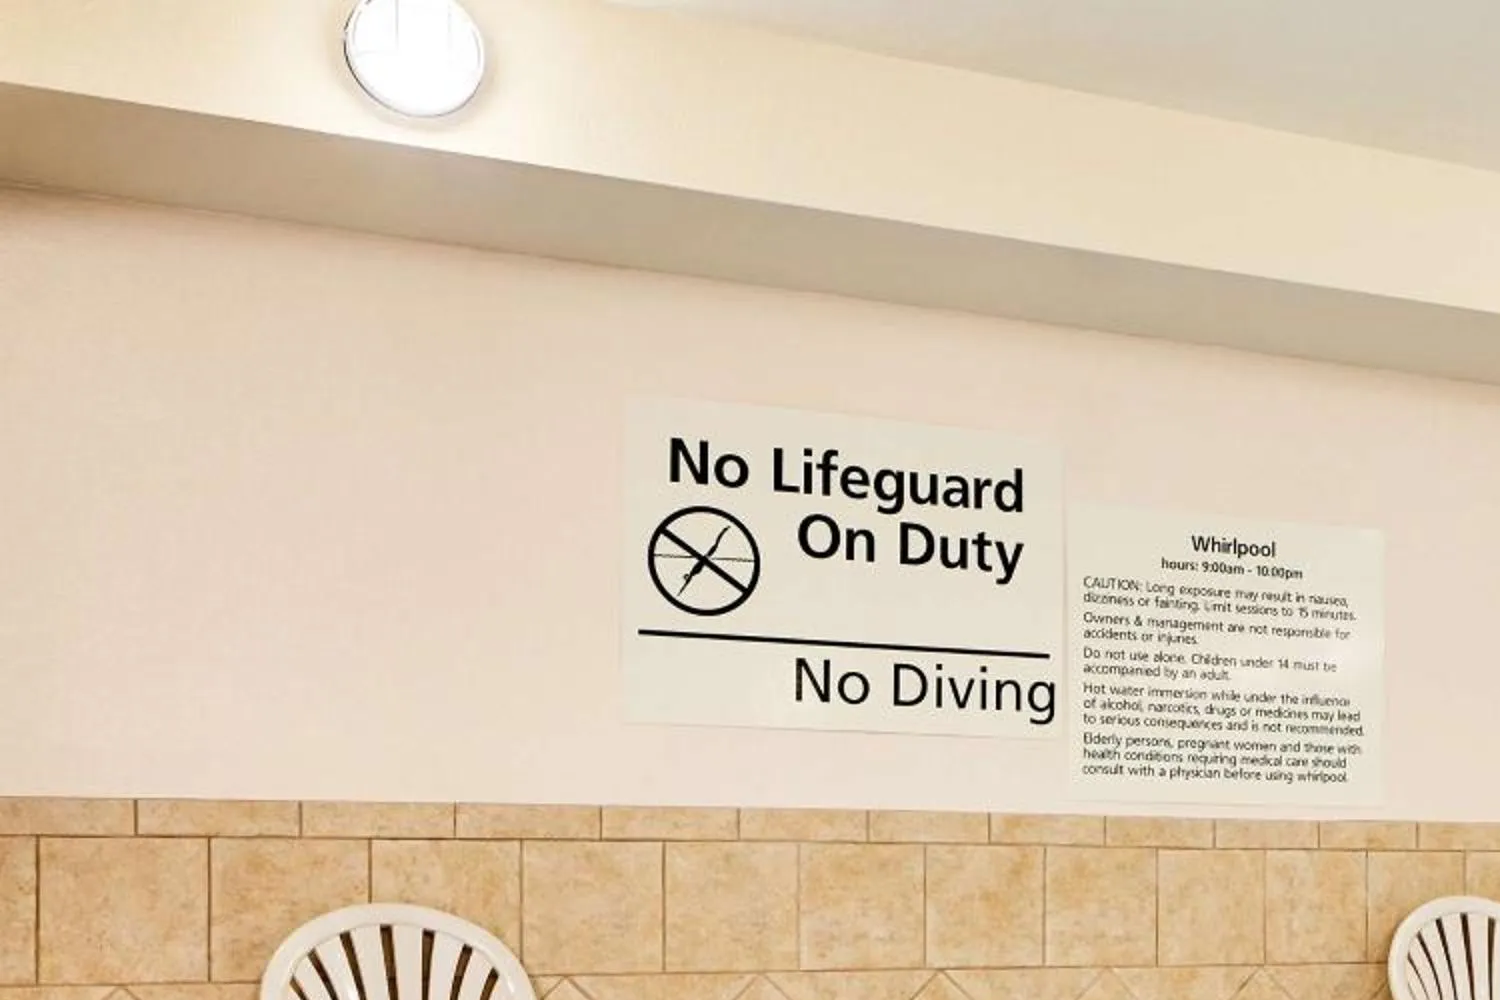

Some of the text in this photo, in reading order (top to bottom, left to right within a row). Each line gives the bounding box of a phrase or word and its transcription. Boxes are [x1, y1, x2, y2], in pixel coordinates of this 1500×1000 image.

[669, 437, 1024, 514] No Lifeguard
[798, 514, 1024, 584] On Duty
[1191, 535, 1276, 558] Whirlpool
[1161, 557, 1198, 571] hours:
[1202, 561, 1244, 574] 9:00am
[1146, 582, 1175, 595] Long
[1179, 585, 1230, 598] exposure
[1236, 590, 1258, 602] may
[1262, 591, 1292, 602] result
[1296, 593, 1305, 602] in
[1138, 598, 1150, 606] or
[1204, 600, 1231, 612] Limit
[1236, 604, 1278, 616] sessions
[1282, 606, 1292, 616] to
[1084, 612, 1350, 640] Owners & management are not responsible for
[1084, 629, 1136, 640] accidents
[1142, 633, 1153, 642] or
[1084, 647, 1100, 658] Do
[1106, 650, 1125, 660] not
[1130, 652, 1149, 661] use
[1192, 653, 1236, 667] Children
[1241, 656, 1273, 668] under
[1278, 659, 1289, 669] 14
[1294, 661, 1319, 671] must
[1324, 662, 1337, 672] be
[1084, 664, 1160, 677] accompanied
[1164, 666, 1178, 680] by
[1183, 669, 1196, 678] an
[795, 658, 1056, 724] No Diving
[1084, 684, 1105, 695] Hot
[1110, 686, 1144, 696] water
[1148, 688, 1206, 700] immersion
[1212, 690, 1240, 702] while
[1244, 692, 1276, 703] under
[1281, 693, 1298, 704] the
[1084, 698, 1096, 709] of
[1205, 704, 1236, 718] drugs
[1240, 708, 1252, 716] or
[1256, 707, 1308, 719] medicines
[1312, 711, 1334, 722] may
[1338, 710, 1360, 721] lead
[1084, 714, 1096, 724] to
[1100, 714, 1140, 726] serious
[1144, 718, 1222, 730] consequences
[1226, 720, 1248, 730] and
[1252, 720, 1258, 732] is
[1264, 723, 1281, 732] not
[1084, 732, 1122, 748] Elderly
[1178, 737, 1230, 752] pregnant
[1234, 741, 1276, 750] women
[1280, 741, 1300, 752] and
[1304, 742, 1334, 753] those
[1338, 744, 1361, 755] with
[1084, 748, 1346, 768] health conditions requiring medical care should
[1083, 763, 1123, 775] consult
[1128, 764, 1154, 776] with
[1159, 767, 1166, 777] a
[1170, 766, 1220, 780] physician
[1224, 768, 1261, 780] before
[1266, 772, 1293, 784] using
